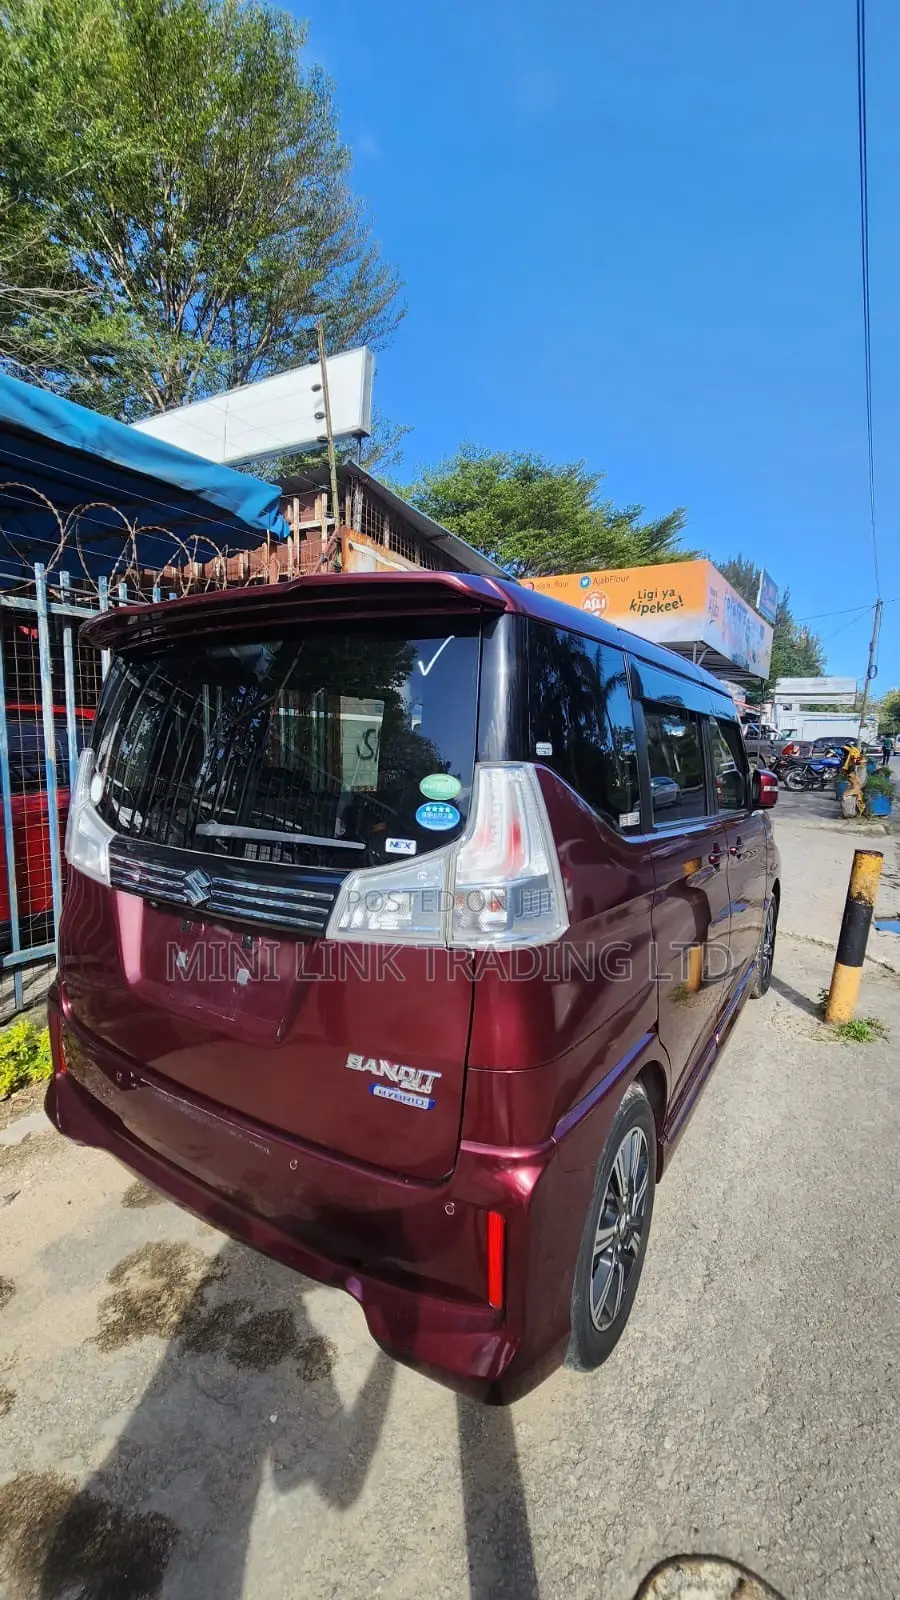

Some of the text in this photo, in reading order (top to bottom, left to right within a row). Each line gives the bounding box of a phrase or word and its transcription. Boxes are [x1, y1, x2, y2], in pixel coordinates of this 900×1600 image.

[637, 588, 676, 602] Ligi ya
[629, 595, 685, 616] kipekee!
[389, 840, 413, 850] NEX
[345, 1052, 442, 1095] BANDIT
[376, 1088, 426, 1108] HYBRID
